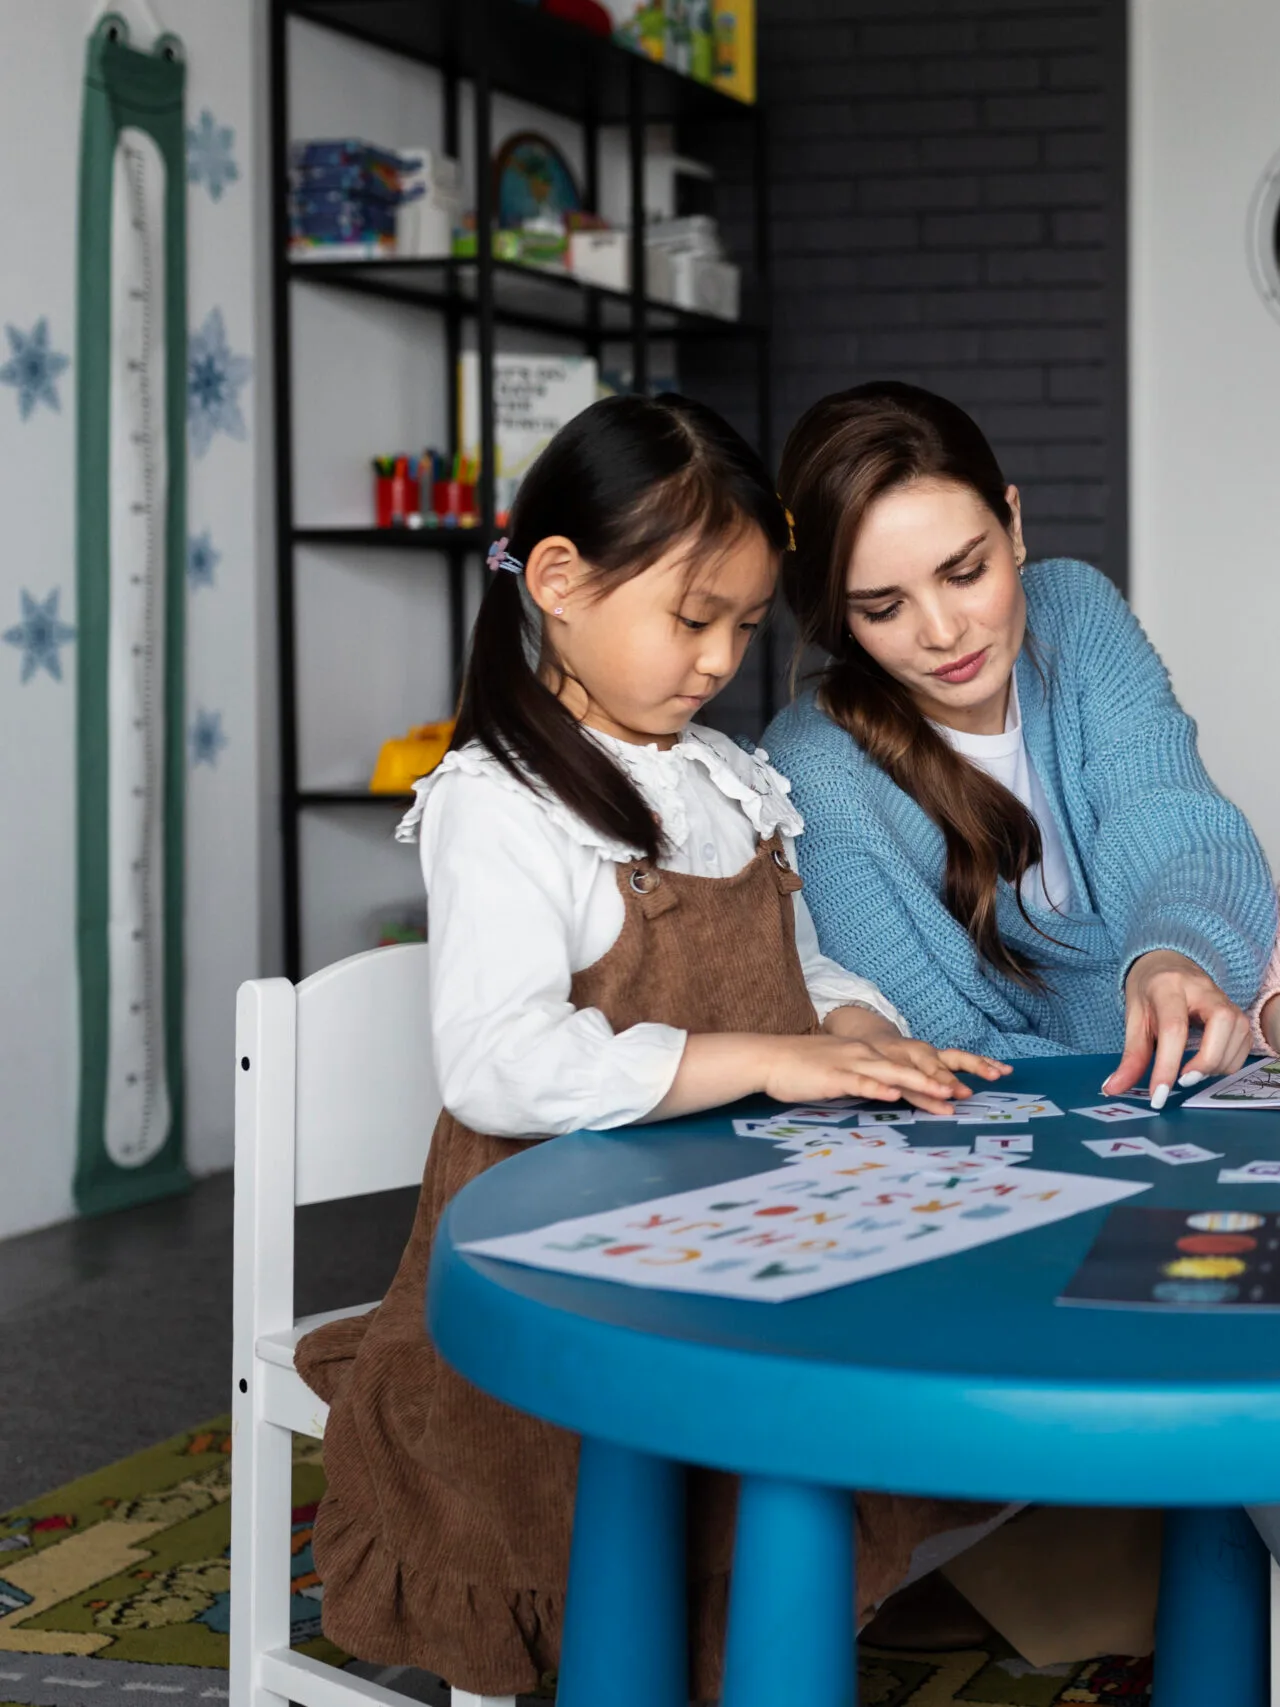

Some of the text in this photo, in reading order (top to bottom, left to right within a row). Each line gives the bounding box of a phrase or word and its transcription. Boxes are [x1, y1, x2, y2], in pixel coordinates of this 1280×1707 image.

[1093, 1107, 1134, 1117] H
[989, 1138, 1020, 1148] T
[638, 1247, 702, 1266] C
[750, 1261, 820, 1280] A
